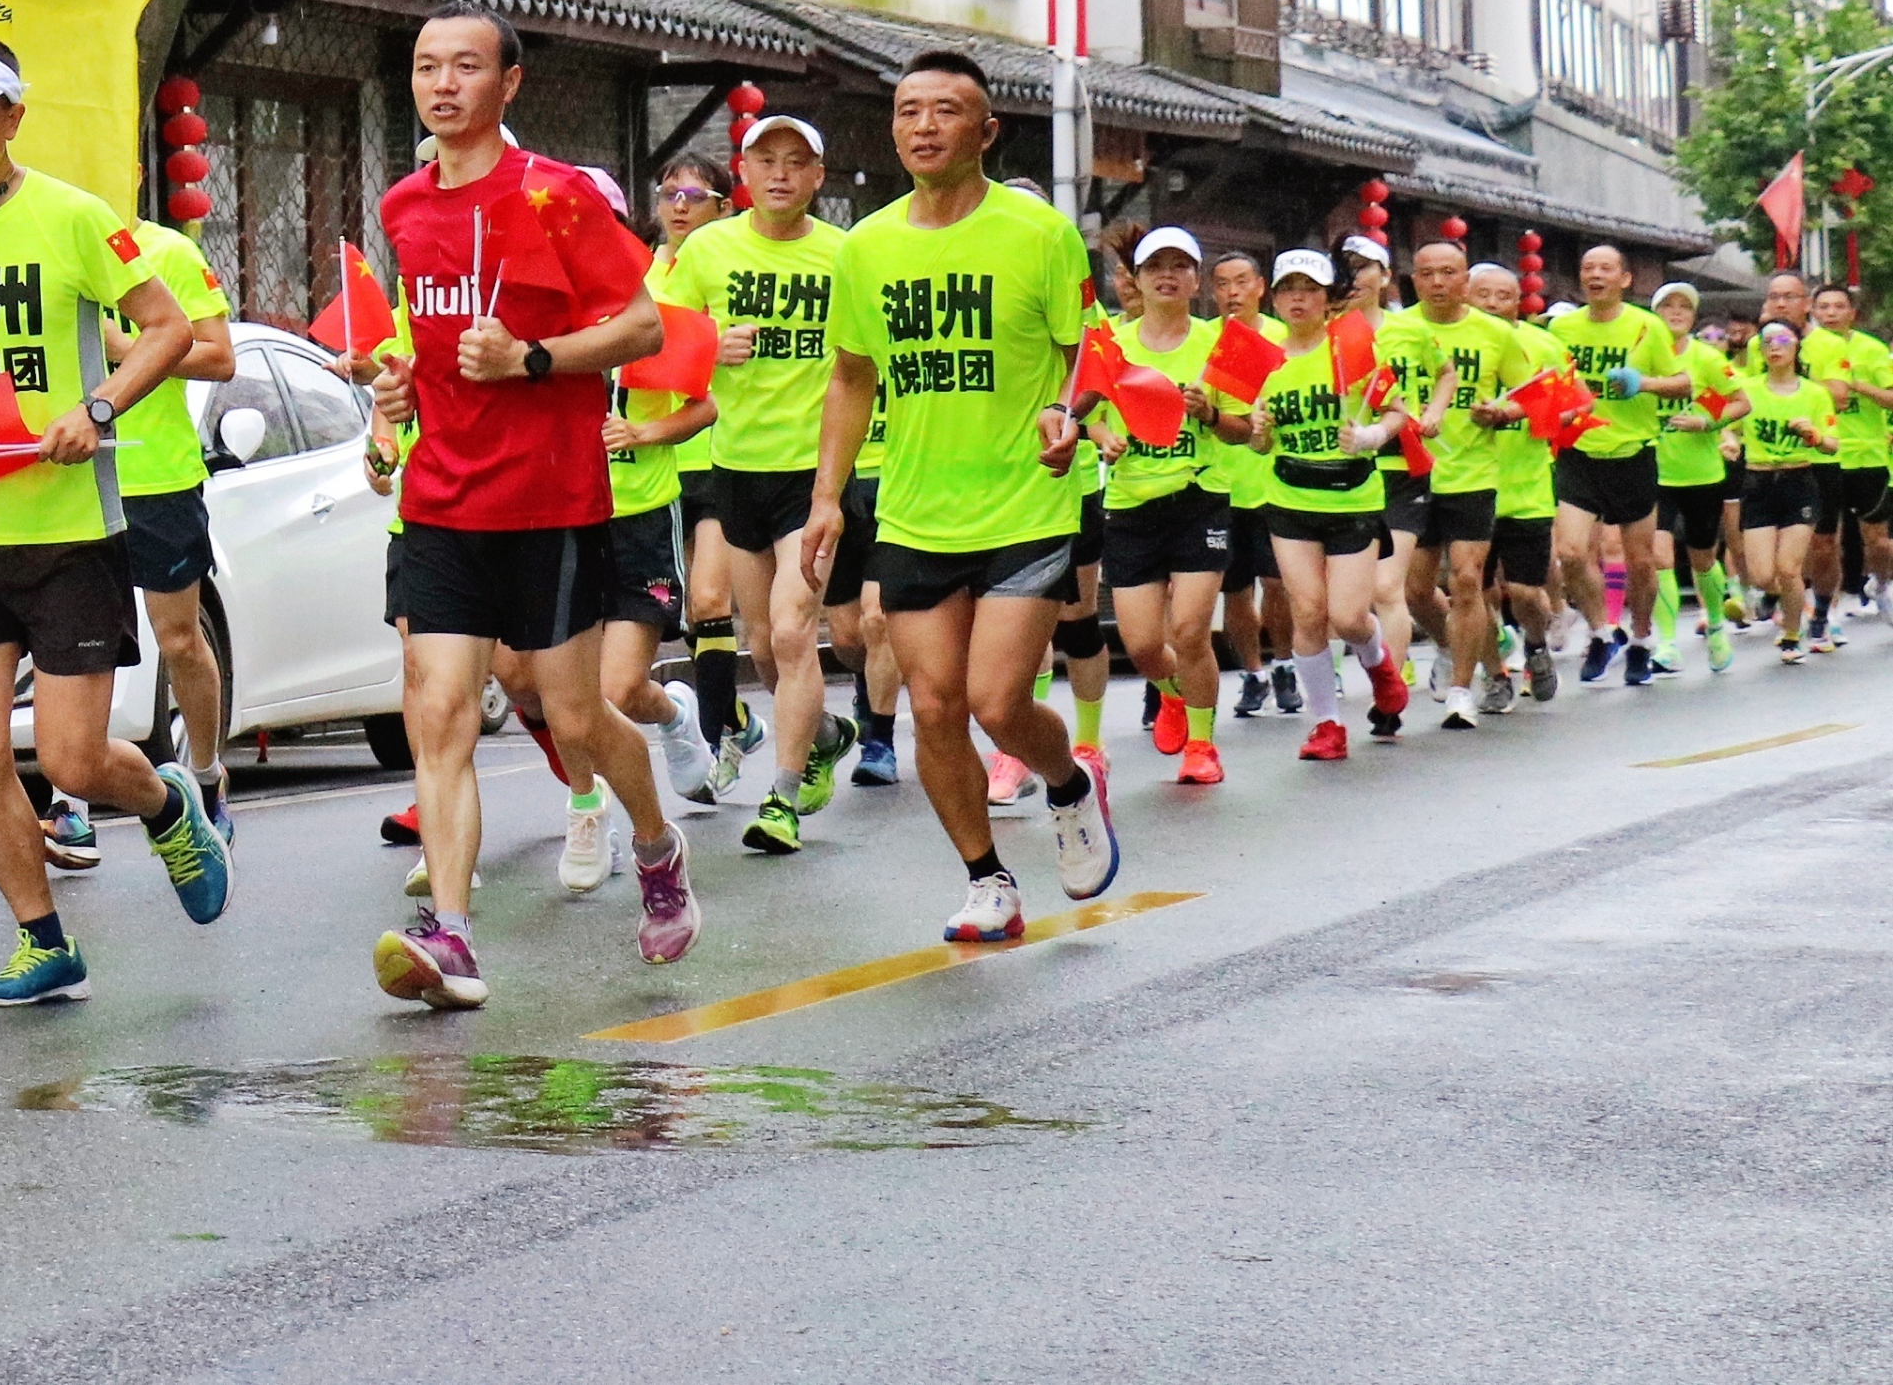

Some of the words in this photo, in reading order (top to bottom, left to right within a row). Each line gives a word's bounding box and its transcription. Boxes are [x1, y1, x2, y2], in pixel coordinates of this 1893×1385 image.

[726, 270, 832, 323] 湖州
[880, 272, 994, 345] 湖州
[729, 324, 826, 360] 跑团
[888, 348, 996, 399] 悦跑团
[1268, 384, 1341, 427] 湖州
